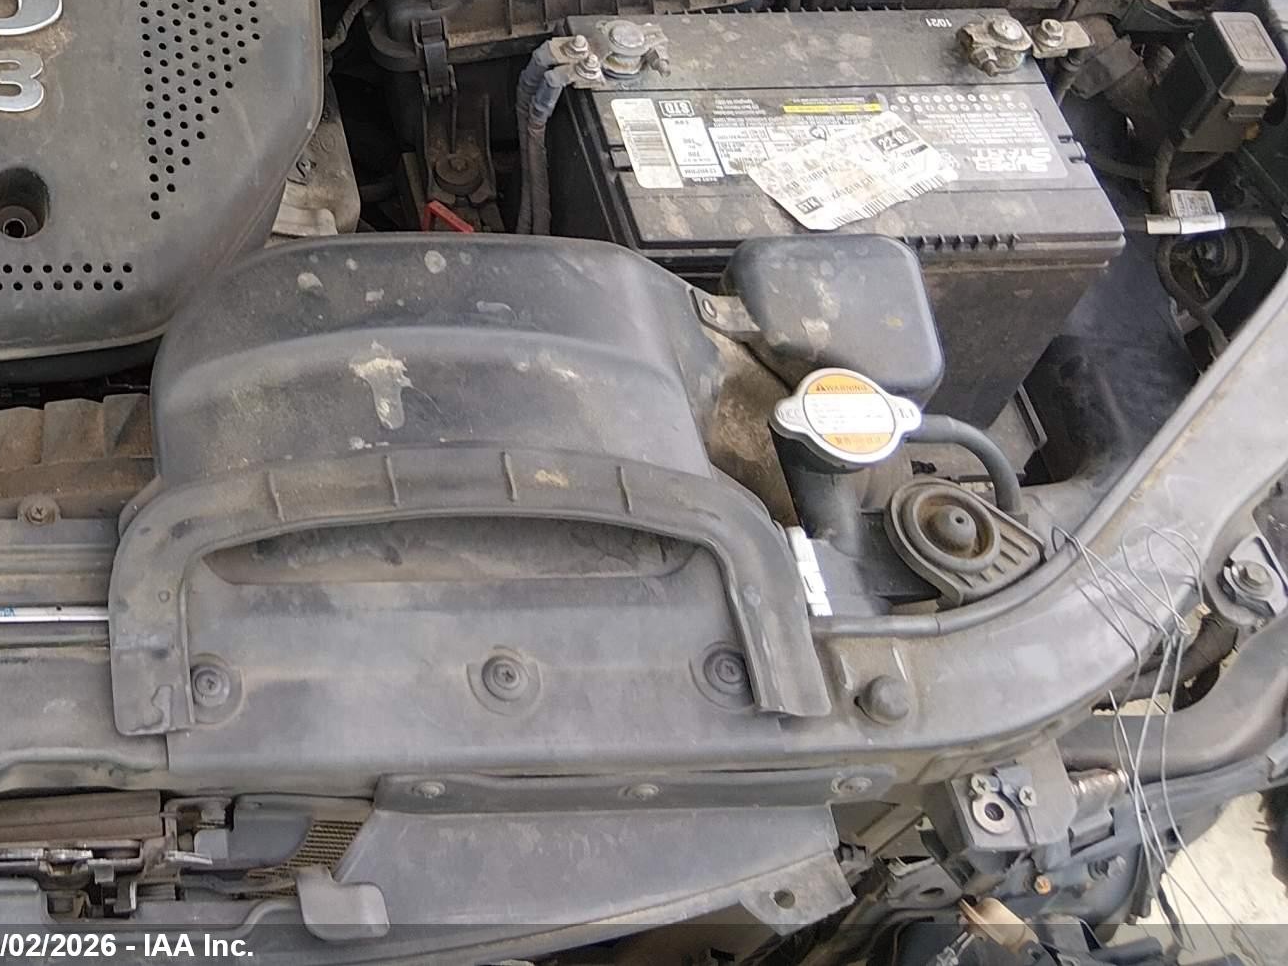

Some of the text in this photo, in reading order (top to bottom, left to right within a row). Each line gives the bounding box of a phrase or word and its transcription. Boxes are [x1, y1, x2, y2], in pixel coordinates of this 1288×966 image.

[924, 17, 953, 28] 10/21
[971, 148, 1052, 162] START
[975, 159, 1048, 172] SUPER
